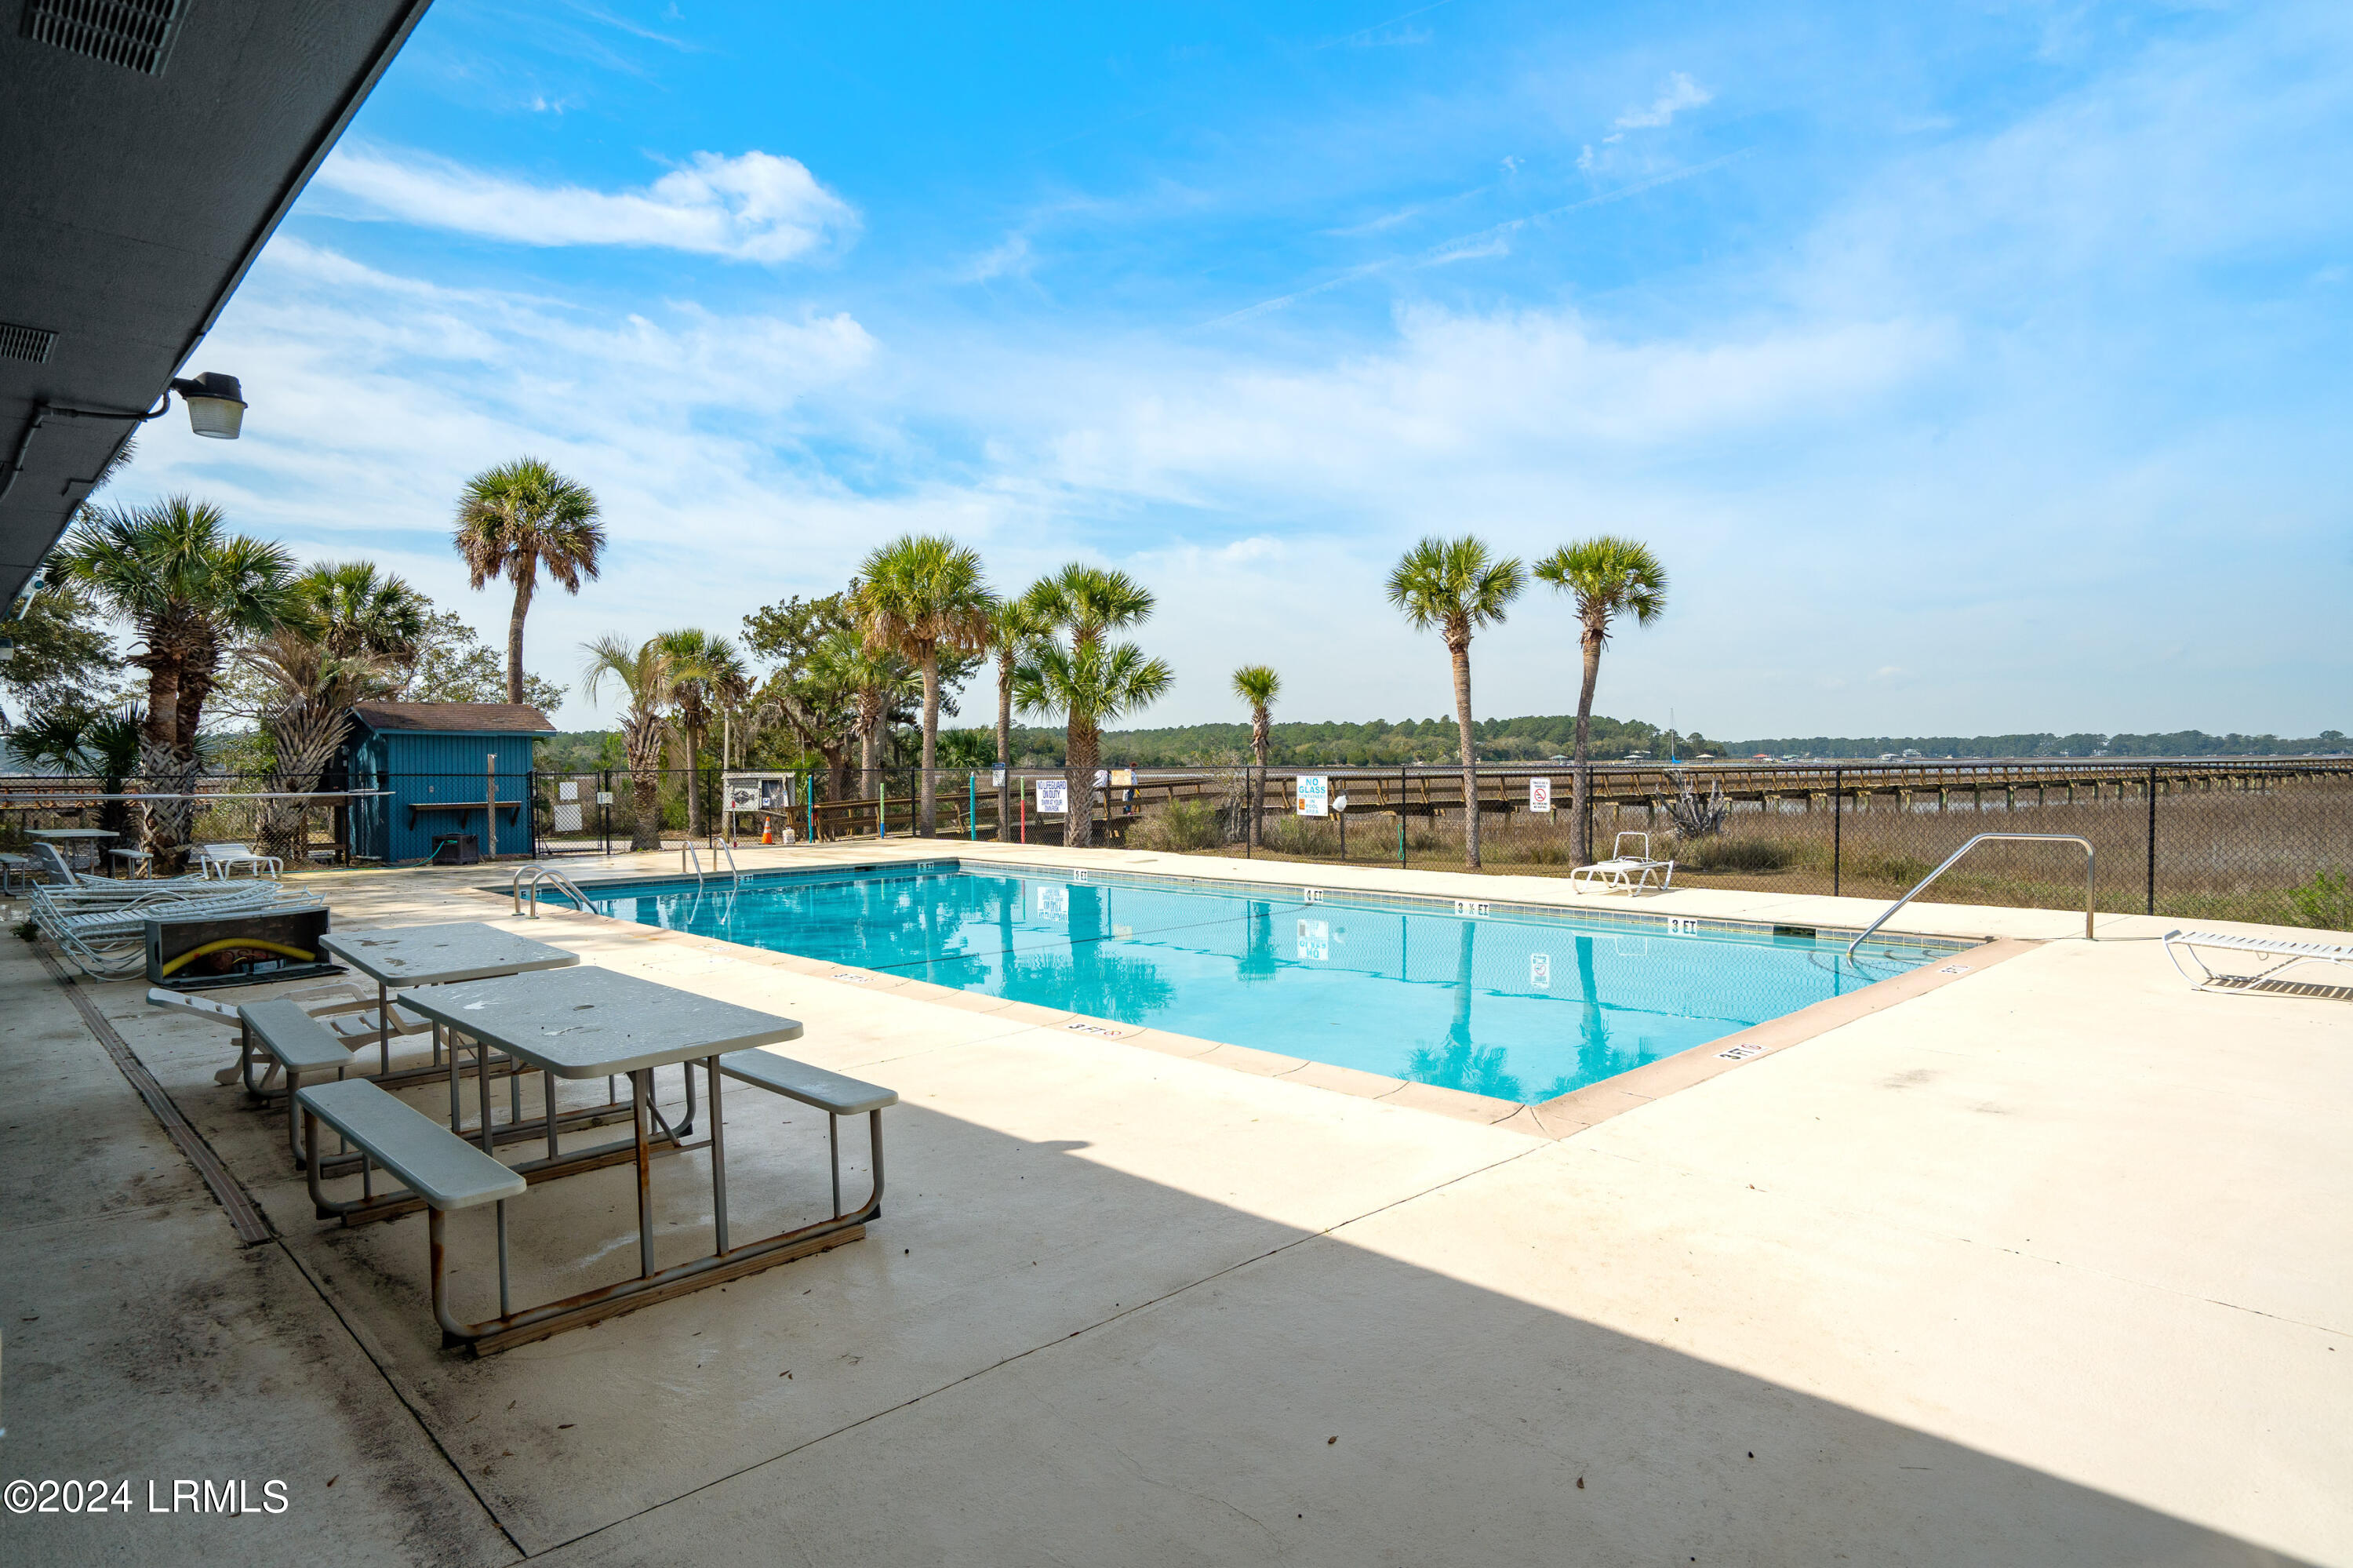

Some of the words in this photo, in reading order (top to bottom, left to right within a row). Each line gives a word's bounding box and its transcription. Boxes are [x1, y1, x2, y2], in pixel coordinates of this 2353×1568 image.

[1037, 780, 1043, 790] NO
[1044, 780, 1067, 790] LIFEGUARD
[1043, 790, 1049, 799] ON
[1049, 790, 1060, 799] DUTY
[1727, 1048, 1755, 1057] FT
